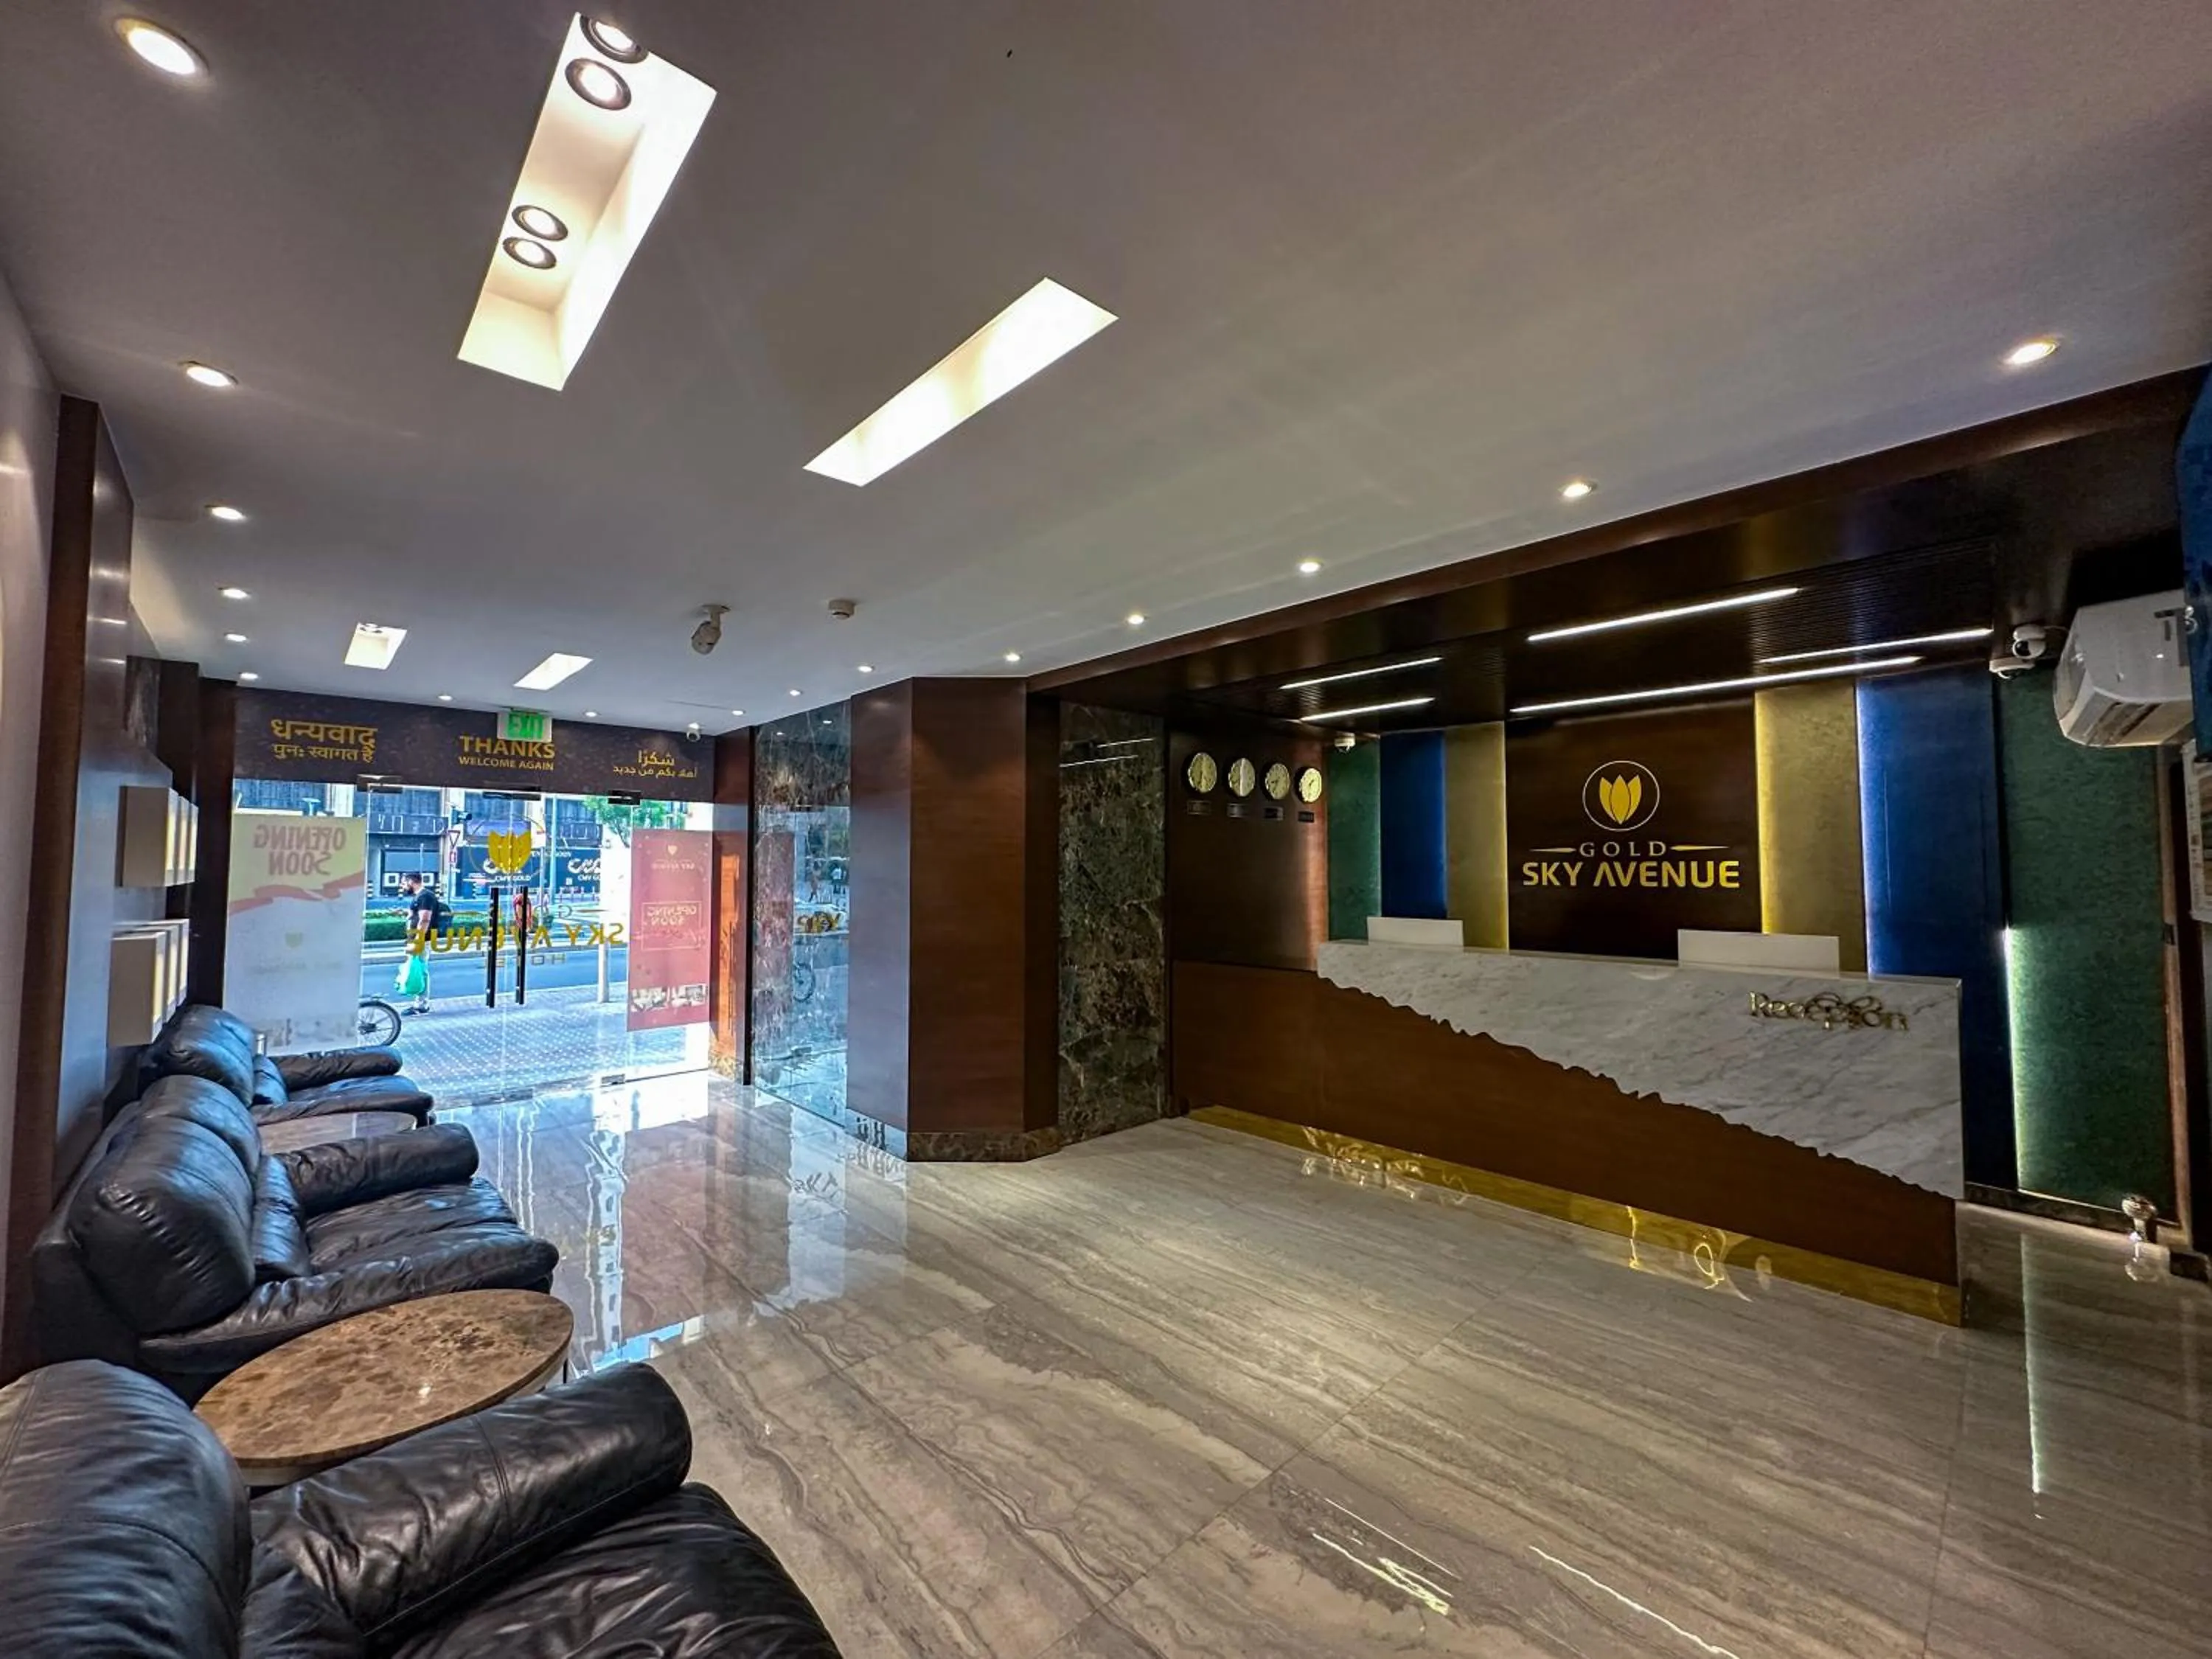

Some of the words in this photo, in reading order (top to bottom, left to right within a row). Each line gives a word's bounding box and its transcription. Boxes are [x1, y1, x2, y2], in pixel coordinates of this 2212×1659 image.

[271, 718, 378, 748] धन्यवाद
[459, 735, 555, 759] THANKS
[459, 756, 516, 768] WELCOME
[518, 760, 554, 771] AGAIN
[1579, 841, 1666, 858] GOLD
[1522, 861, 1584, 886] SKY
[1593, 860, 1740, 888] AVENUE
